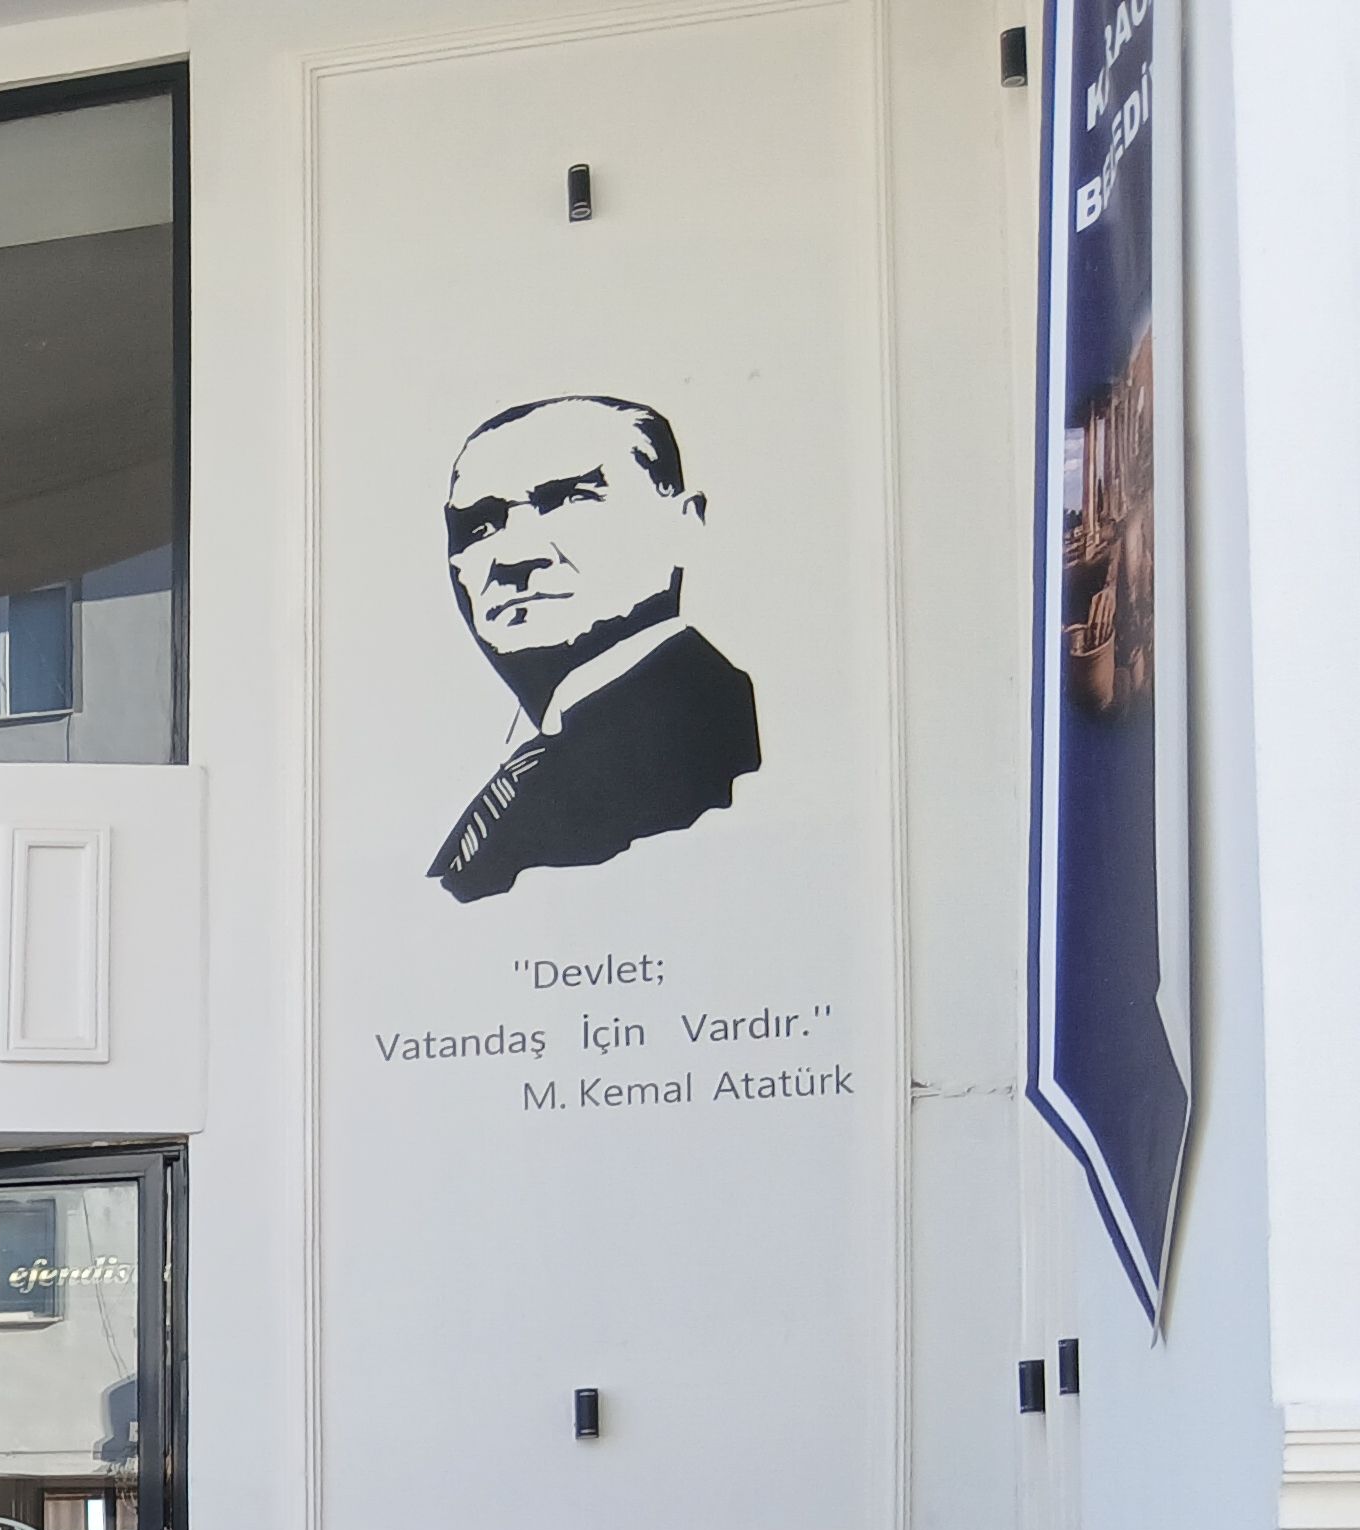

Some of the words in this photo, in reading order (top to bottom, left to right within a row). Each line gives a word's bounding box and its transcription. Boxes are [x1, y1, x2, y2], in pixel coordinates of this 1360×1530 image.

[374, 1024, 547, 1062] Vatandaş
[581, 1013, 646, 1055] İçin
[522, 1081, 567, 1111] M.
[579, 1071, 693, 1108] Kemal
[712, 1063, 855, 1101] Atatürk
